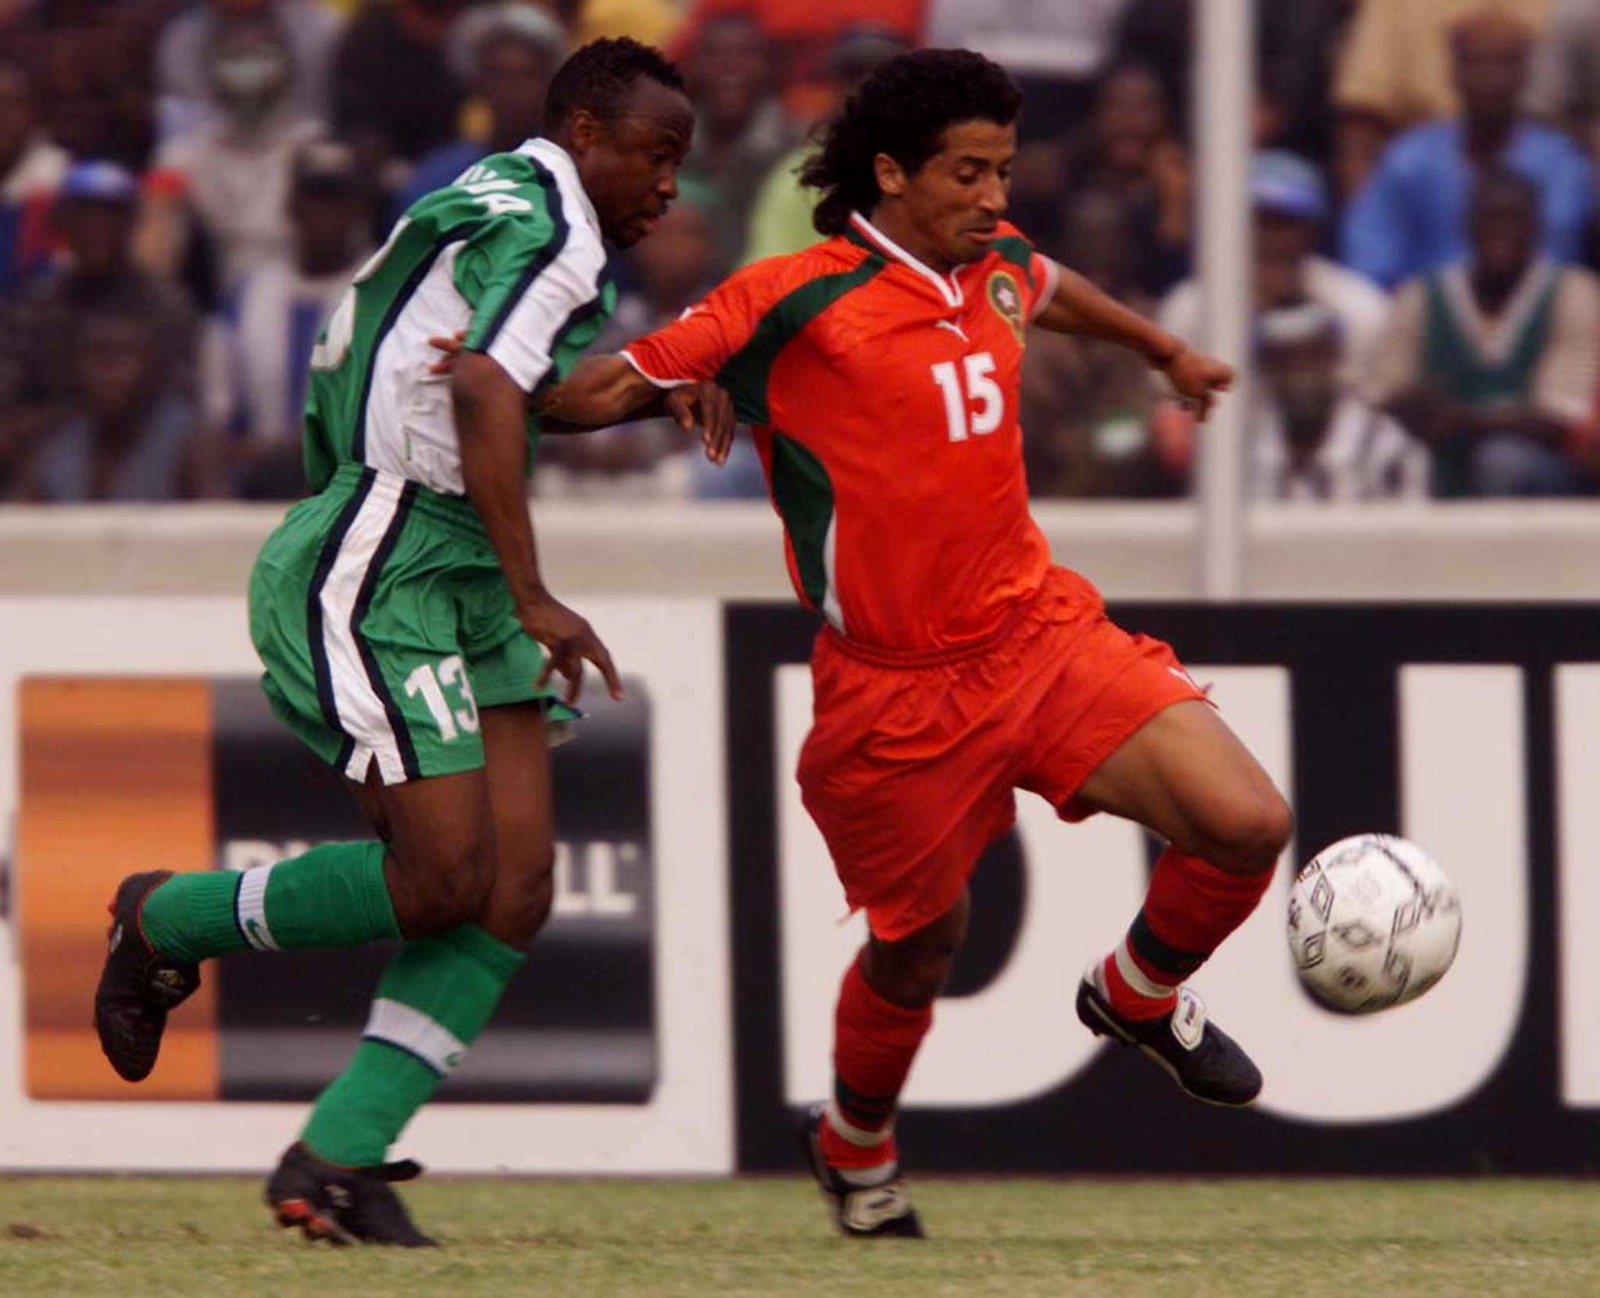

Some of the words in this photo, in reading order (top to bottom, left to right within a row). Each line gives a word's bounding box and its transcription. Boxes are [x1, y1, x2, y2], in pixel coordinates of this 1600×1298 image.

[930, 352, 1004, 442] 15
[404, 655, 479, 741] 13
[774, 664, 1600, 1123] DU
